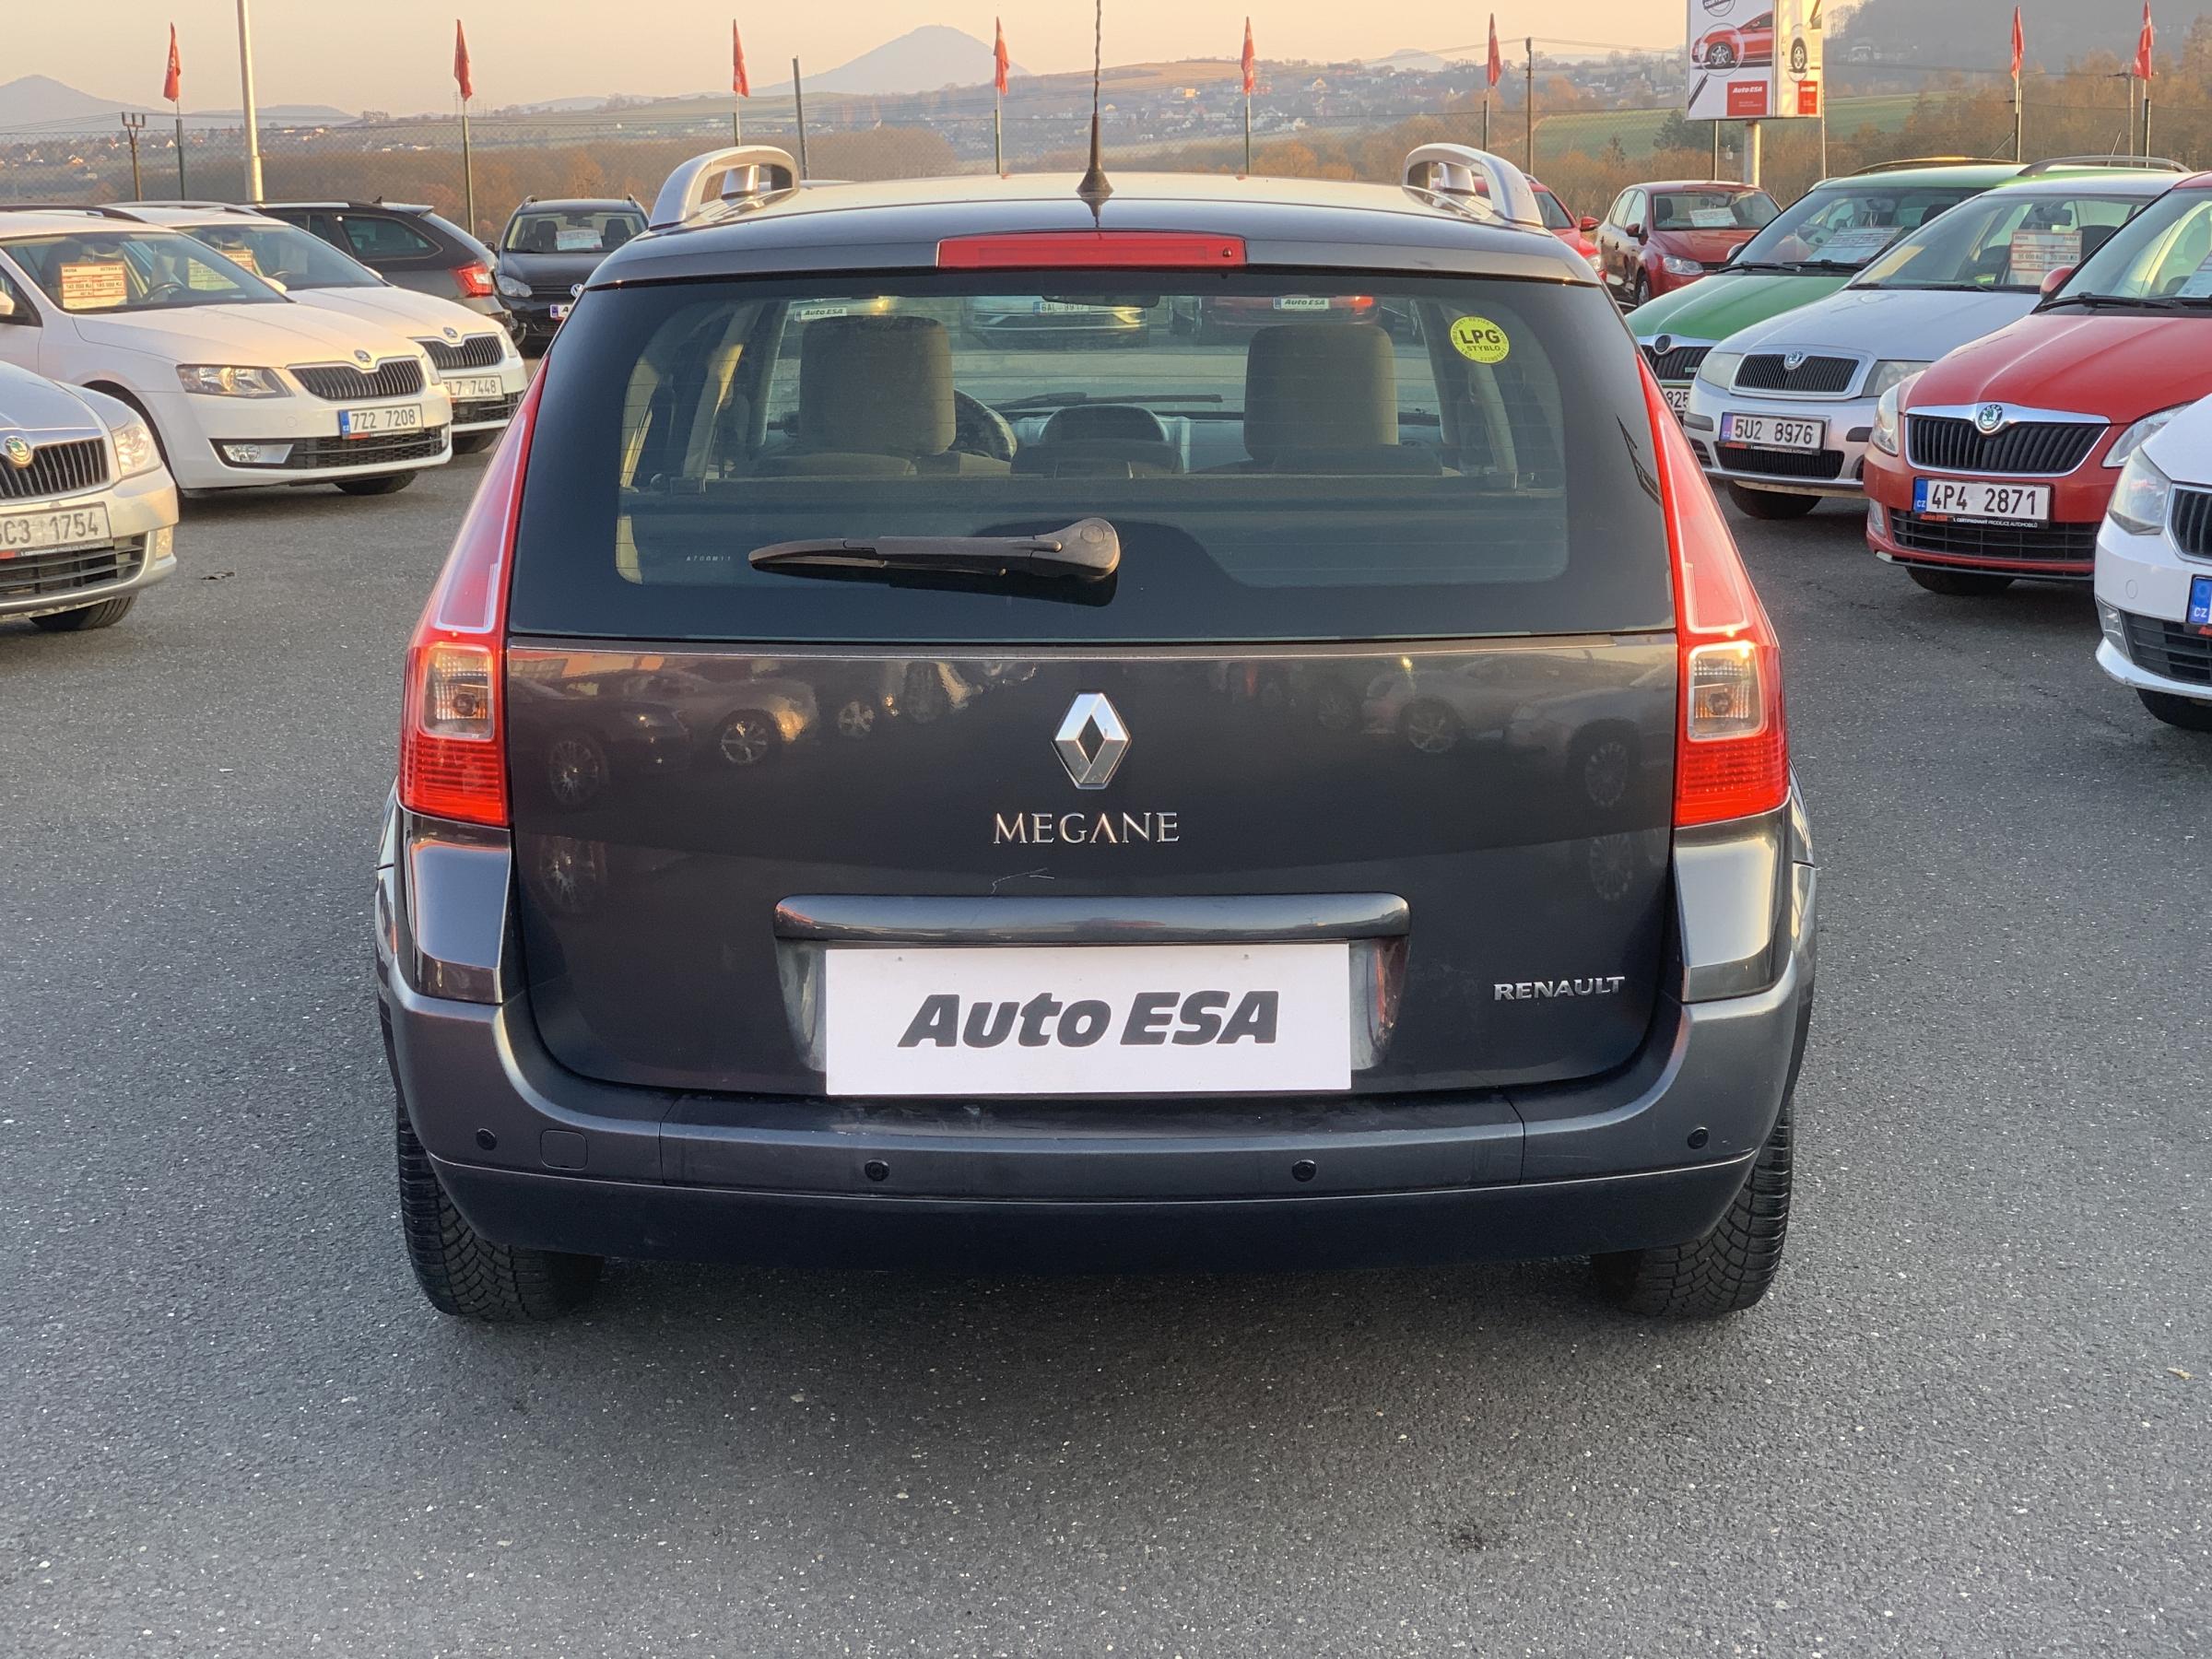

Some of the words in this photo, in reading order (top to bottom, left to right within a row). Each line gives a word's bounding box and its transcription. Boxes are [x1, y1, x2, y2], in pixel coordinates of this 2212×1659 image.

[1459, 329, 1500, 344] LPG
[470, 380, 497, 394] 7448
[352, 412, 376, 430] 7Z2
[385, 408, 416, 428] 7208
[1735, 418, 1762, 441] 5U2
[1774, 422, 1814, 444] 8976
[1916, 500, 1926, 508] CZ
[1932, 484, 1968, 511] 4P4
[1983, 488, 2036, 515] 2871
[0, 519, 31, 545] C3
[49, 512, 99, 540] 1754
[2194, 606, 2207, 618] CZ
[993, 811, 1180, 844] MEGANE
[1493, 975, 1626, 1001] RENAULT
[897, 992, 1112, 1049] Auto
[1119, 990, 1279, 1046] ESA
